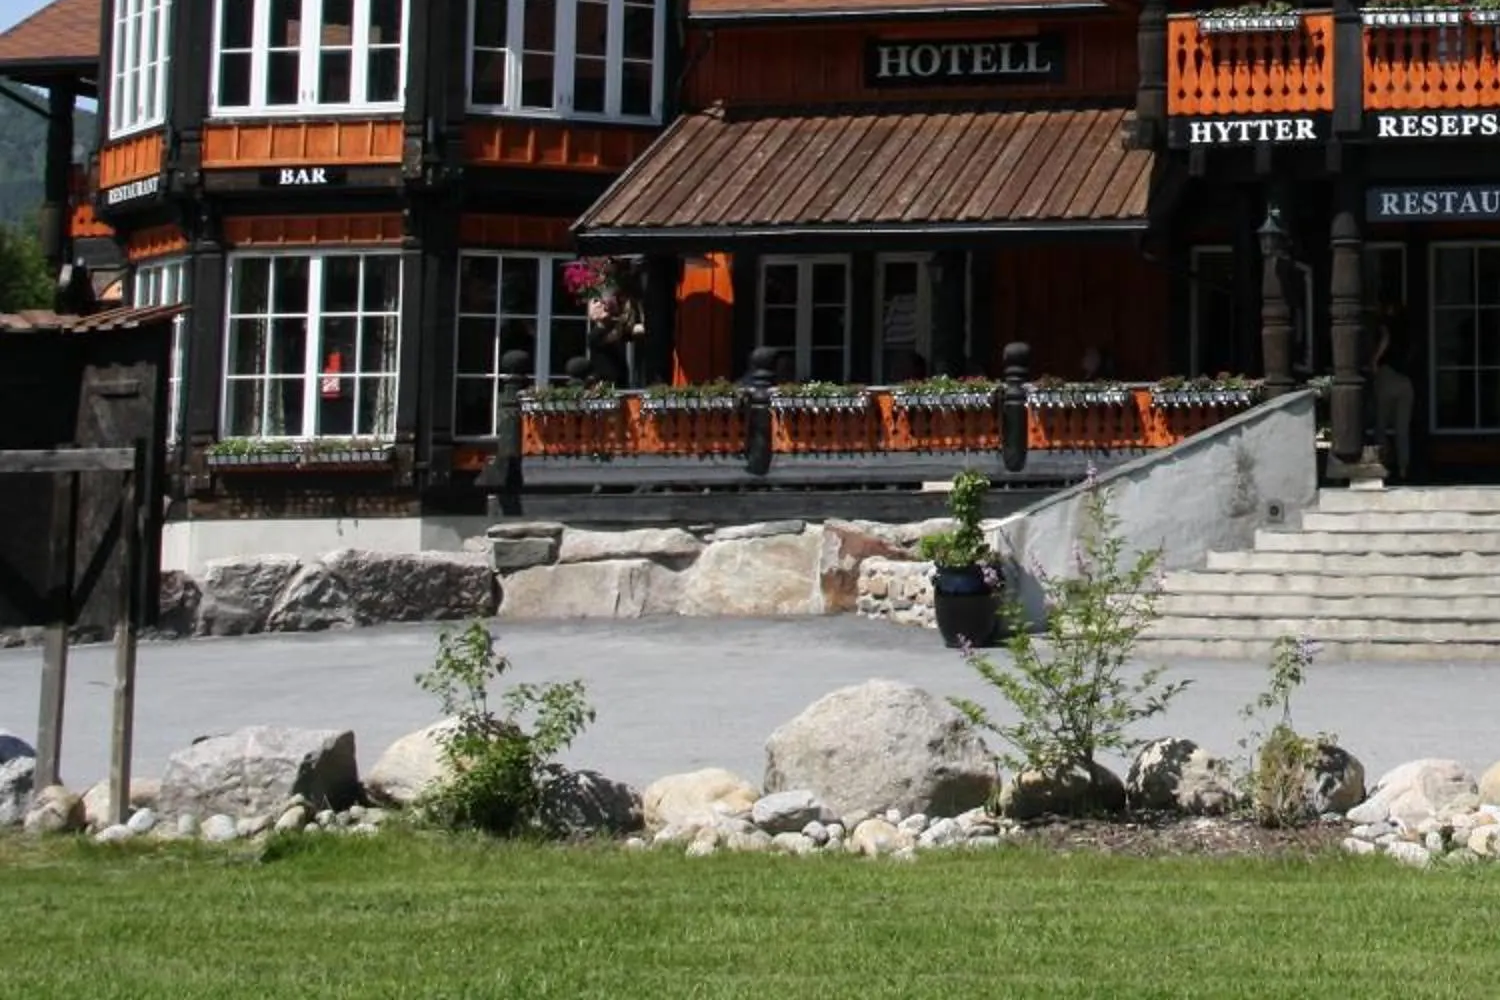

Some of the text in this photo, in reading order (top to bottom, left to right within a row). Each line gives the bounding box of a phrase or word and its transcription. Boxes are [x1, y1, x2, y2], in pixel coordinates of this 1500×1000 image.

[876, 41, 1051, 78] HOTELL
[1189, 118, 1317, 143] HYTTER
[279, 167, 328, 185] BAR
